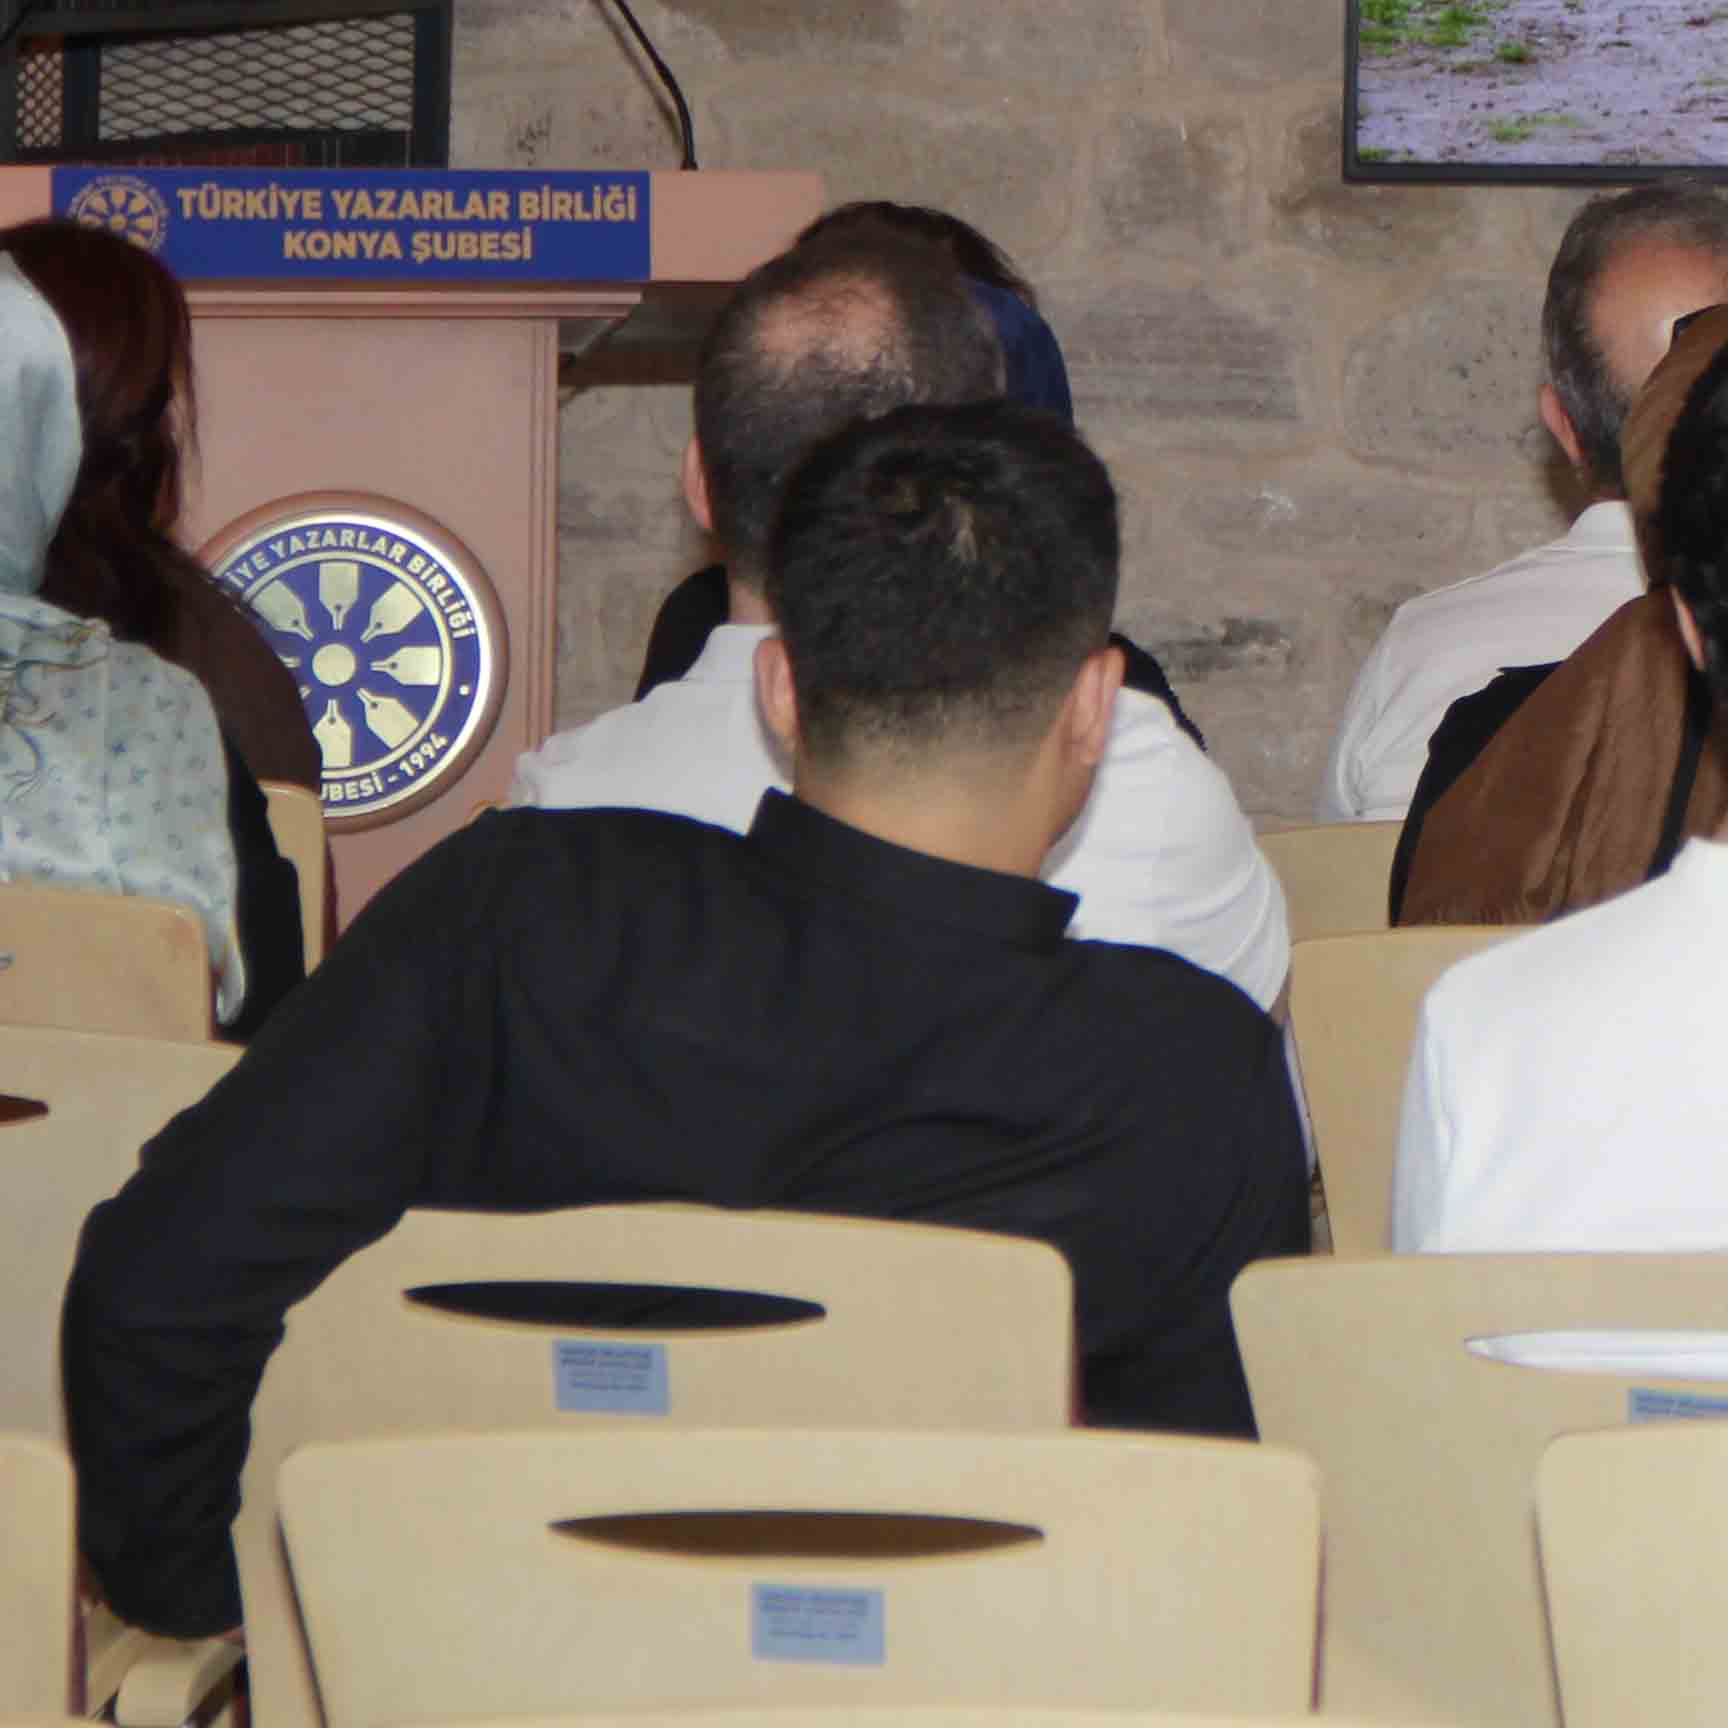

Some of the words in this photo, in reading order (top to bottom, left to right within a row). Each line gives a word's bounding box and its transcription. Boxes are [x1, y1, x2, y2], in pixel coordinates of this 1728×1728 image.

[176, 182, 322, 220] TÜRKİYE
[331, 188, 510, 221] YAZARLAR
[518, 185, 636, 221] BİRLİĞİ
[283, 230, 402, 260] KONYA
[411, 225, 532, 264] ŞUBESİ
[269, 528, 408, 563] YAZARLAR
[406, 554, 476, 639] BİRLİĞİ
[320, 774, 384, 802] BESİ
[399, 732, 448, 777] 1994
